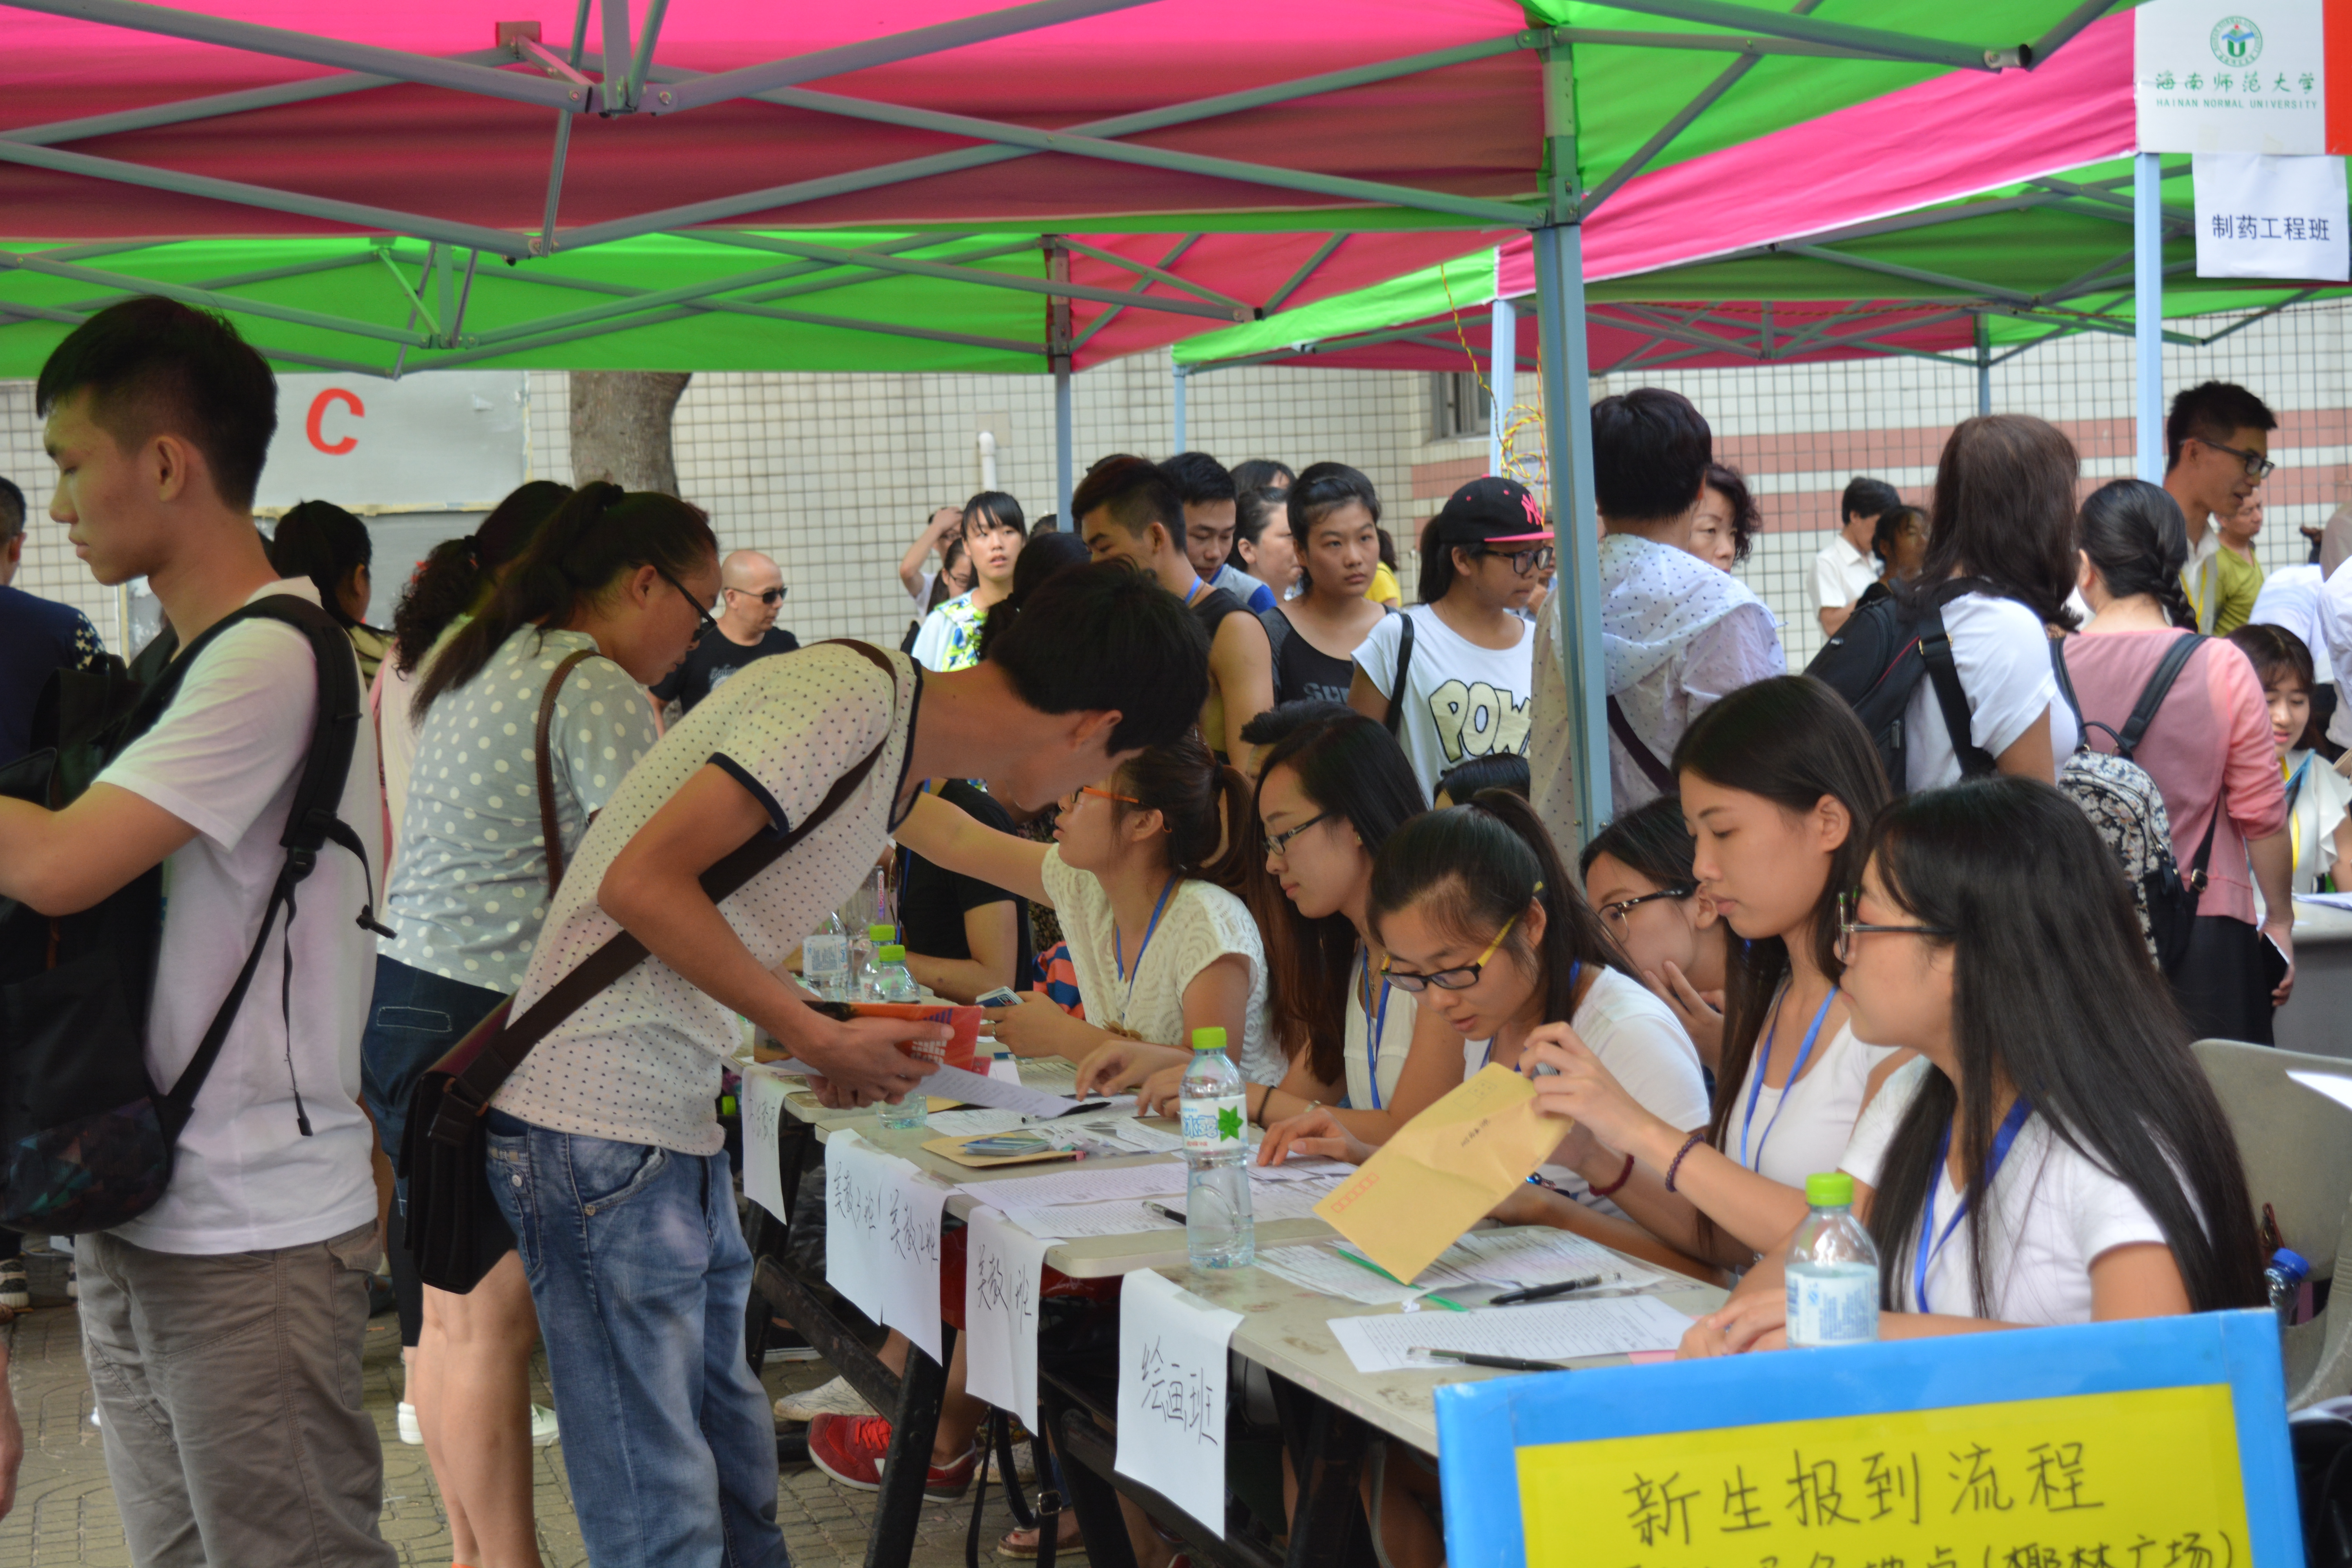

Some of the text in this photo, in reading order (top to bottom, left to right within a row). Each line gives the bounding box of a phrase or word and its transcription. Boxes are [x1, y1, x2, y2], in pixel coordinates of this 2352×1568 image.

[2156, 70, 2315, 94] 海南师范大学
[2156, 99, 2317, 109] HAINAN NORMAL UNIVERSITY
[2212, 214, 2330, 241] 制药工程班
[306, 388, 365, 456] C
[1141, 1335, 1218, 1446] 绘画班
[1622, 1441, 2105, 1547] 新生报到流程
